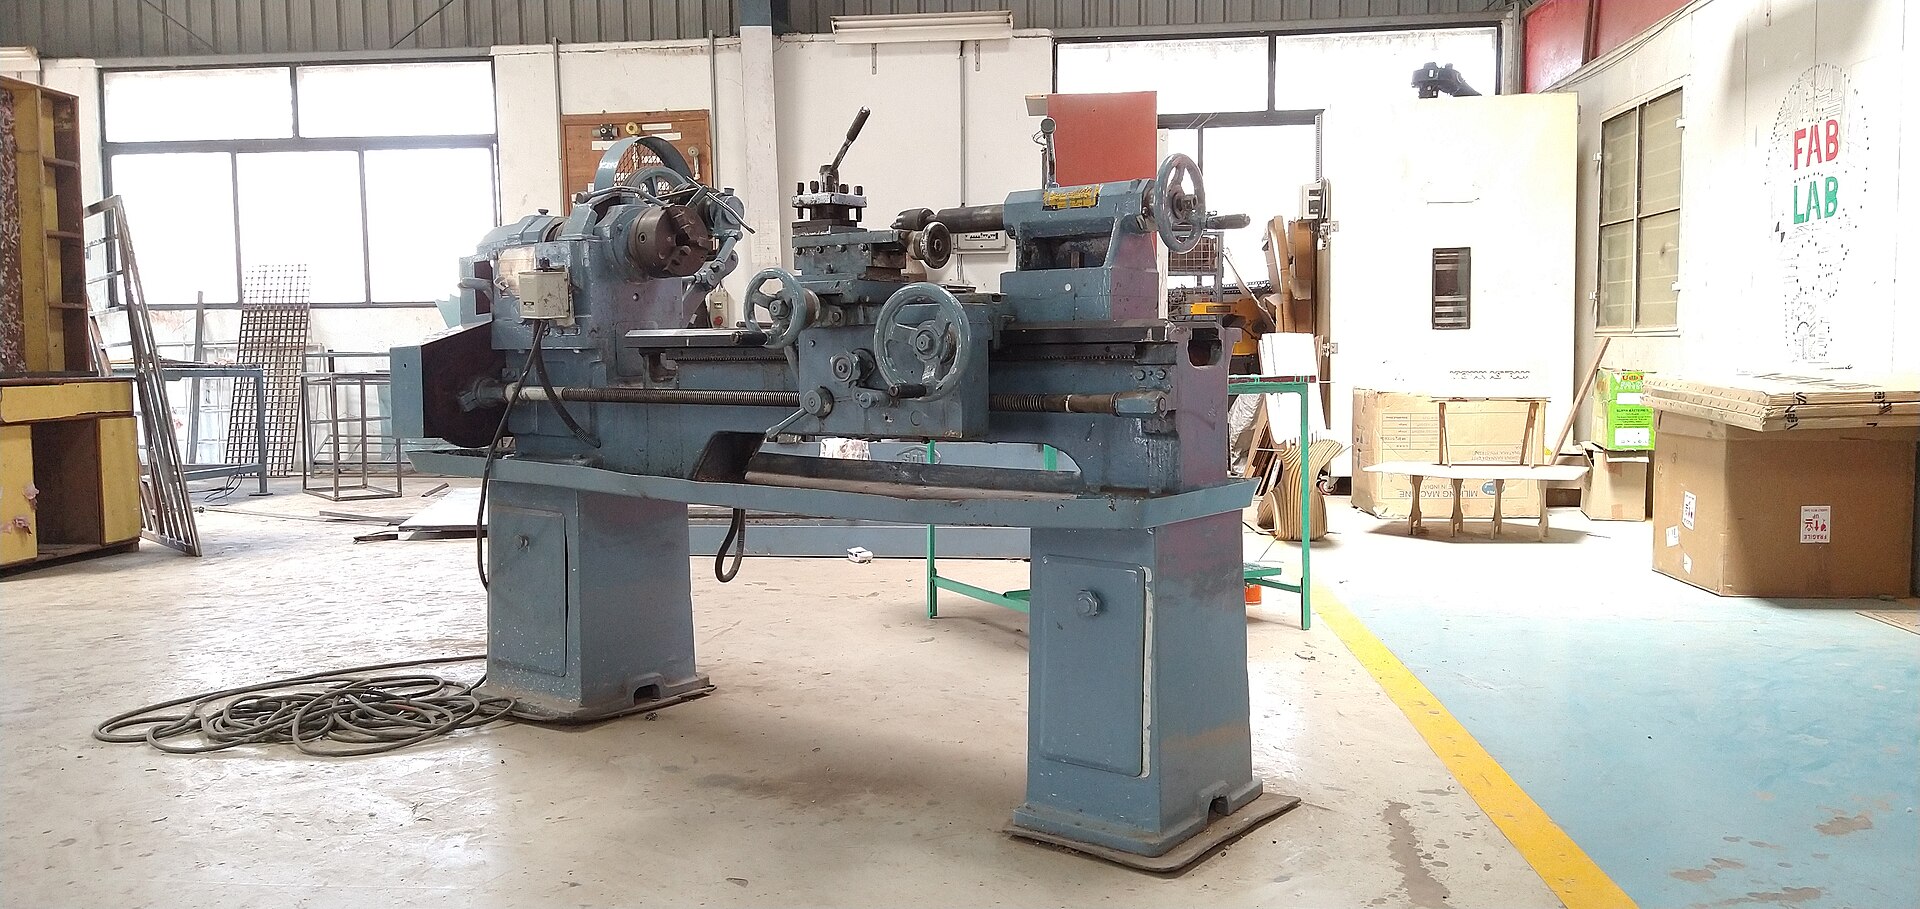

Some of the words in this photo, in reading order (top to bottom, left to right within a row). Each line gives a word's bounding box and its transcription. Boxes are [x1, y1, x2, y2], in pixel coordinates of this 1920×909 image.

[1793, 119, 1839, 170] FAB
[1793, 176, 1839, 224] LAB
[1399, 490, 1440, 498] MACNE
[1442, 490, 1478, 498] MILNG
